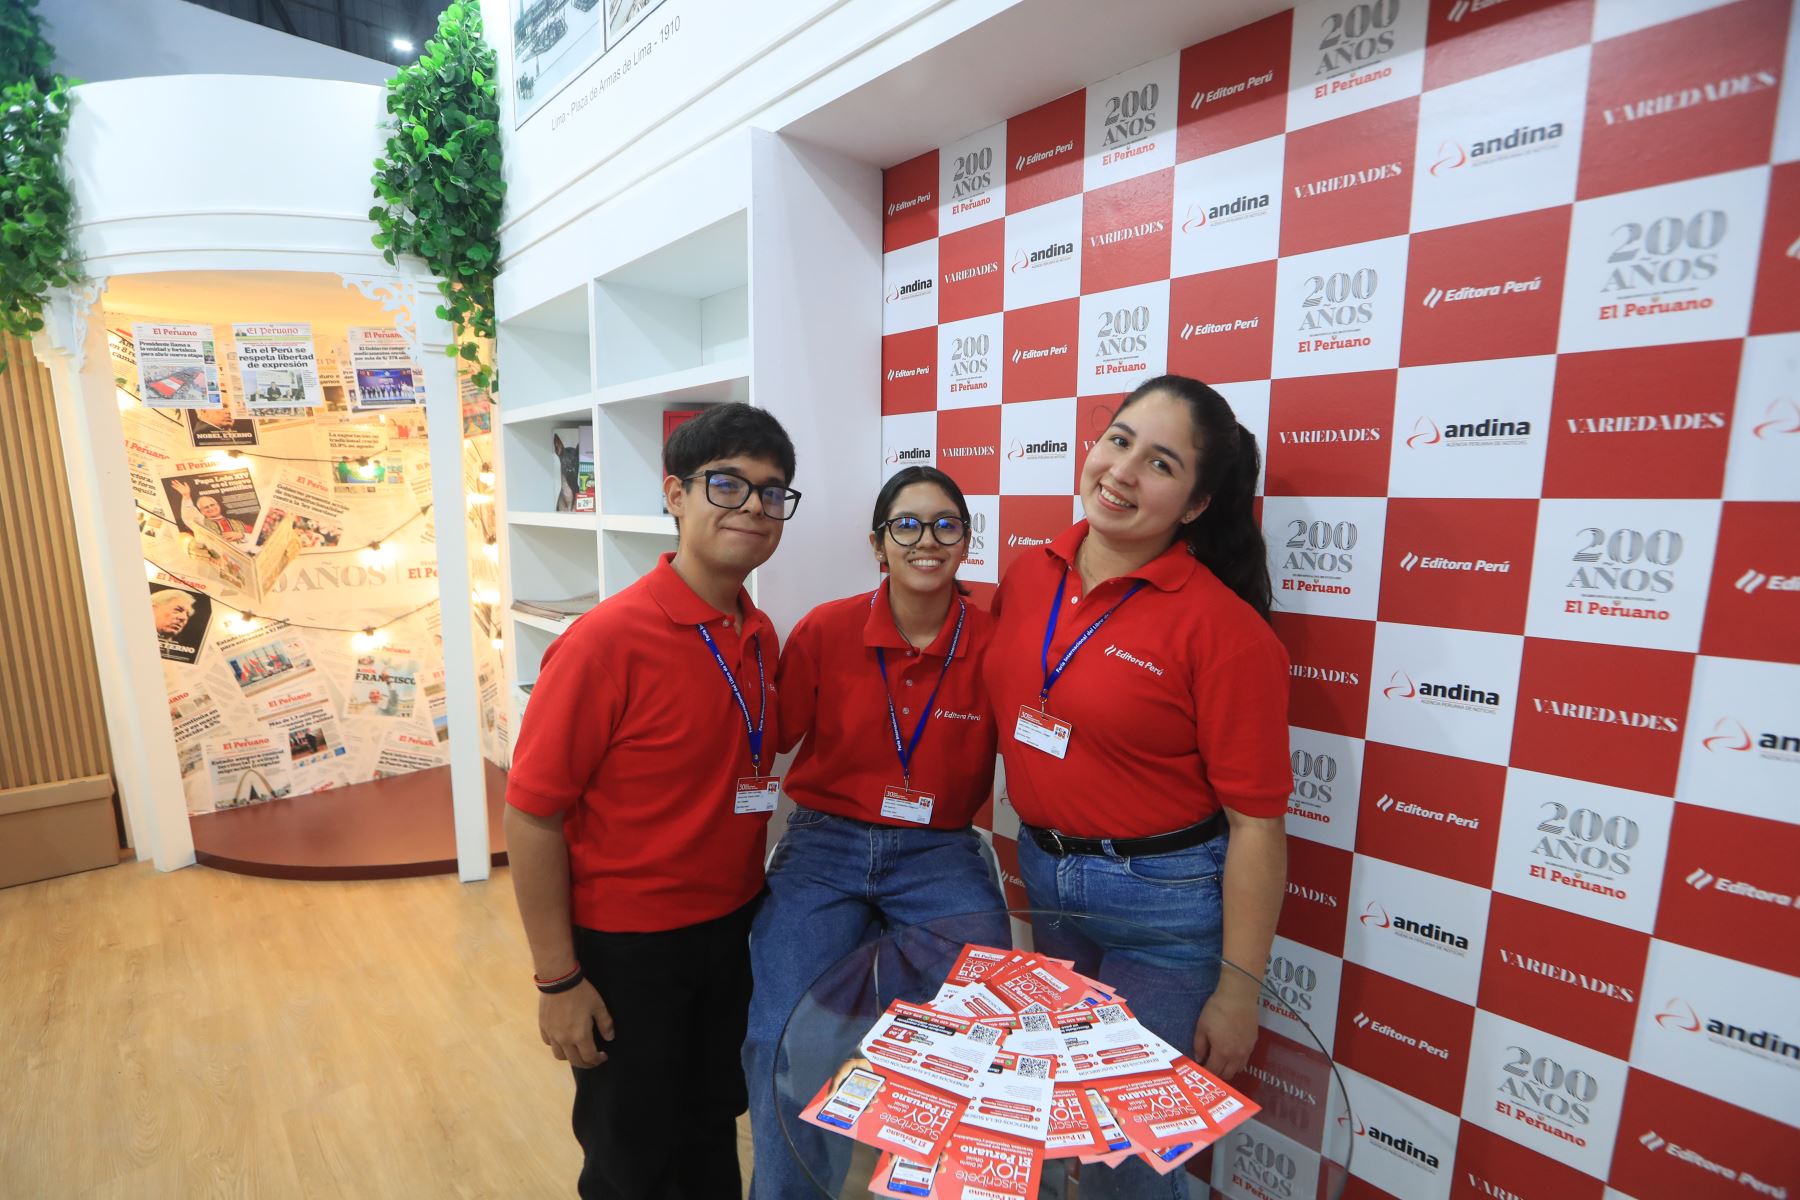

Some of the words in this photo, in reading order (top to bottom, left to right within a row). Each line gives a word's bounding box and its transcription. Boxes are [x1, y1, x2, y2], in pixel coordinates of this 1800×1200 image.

[1318, 0, 1399, 50] 200
[1315, 30, 1394, 76] AÑOS
[551, 112, 566, 131] Lima
[570, 97, 589, 116] Plaza
[590, 86, 598, 99] de
[600, 71, 621, 93] Armas
[623, 58, 631, 74] de
[634, 42, 652, 66] Lima
[660, 15, 681, 44] 1910
[1314, 85, 1328, 99] El
[1331, 67, 1392, 94] Peruano
[1206, 83, 1244, 102] Editora
[1247, 70, 1273, 92] Perú
[1602, 69, 1778, 125] VARIEDADES
[1105, 83, 1159, 126] 200
[1102, 112, 1156, 147] AÑOS
[1470, 121, 1563, 159] andina
[954, 147, 992, 181] 200
[1026, 150, 1054, 165] Editora
[1055, 140, 1073, 156] Perú
[1102, 155, 1112, 166] El
[1114, 142, 1155, 162] Peruano
[952, 171, 991, 198] AÑOS
[1294, 162, 1402, 198] VARIEDADES
[895, 198, 917, 212] Editora
[918, 192, 931, 206] Perú
[952, 204, 960, 215] El
[963, 196, 991, 213] Peruano
[1208, 194, 1270, 219] andina
[1090, 220, 1164, 247] VARIEDADES
[1606, 208, 1728, 264] 200
[1030, 242, 1073, 262] andina
[944, 262, 998, 284] VARIEDADES
[1600, 252, 1718, 294] AÑOS
[900, 278, 932, 296] andina
[1302, 268, 1378, 308] 200
[1444, 284, 1500, 303] Editora
[1503, 277, 1542, 296] Perú
[1299, 302, 1373, 331] AÑOS
[1598, 305, 1618, 321] El
[1623, 295, 1713, 318] Peruano
[164, 328, 197, 336] Peruano
[261, 327, 298, 336] Peruano
[1097, 305, 1150, 338] 200
[1194, 322, 1231, 335] Editora
[1234, 317, 1259, 330] Perú
[951, 333, 989, 360] 200
[1023, 348, 1049, 359] Editora
[1050, 344, 1068, 356] Perú
[1095, 334, 1147, 357] AÑOS
[1298, 341, 1313, 354] El
[1314, 336, 1371, 352] Peruano
[262, 361, 308, 369] expresión
[895, 367, 915, 378] Editora
[916, 366, 929, 376] Perú
[950, 357, 988, 377] AÑOS
[1095, 365, 1105, 375] El
[1106, 361, 1146, 374] Peruano
[950, 383, 958, 392] El
[960, 381, 987, 391] Peruano
[1444, 418, 1530, 439] andina
[1567, 412, 1725, 433] VARIEDADES
[1026, 440, 1067, 454] andina
[1279, 427, 1380, 444] VARIEDADES
[899, 448, 930, 459] andina
[942, 446, 995, 458] VARIEDADES
[1286, 520, 1357, 550] 200
[1572, 527, 1684, 566] 200
[1282, 547, 1353, 573] AÑOS
[1420, 557, 1472, 571] Editora
[1474, 560, 1510, 573] Perú
[292, 560, 386, 591] AÑOS
[408, 568, 421, 579] El
[1565, 562, 1675, 594] AÑOS
[1282, 579, 1294, 590] El
[1297, 580, 1351, 594] Peruano
[1564, 600, 1582, 613] El
[1587, 602, 1670, 620] Peruano
[1056, 661, 1066, 673] Feria
[1064, 634, 1087, 662] Internacional
[1086, 627, 1094, 636] del
[1093, 617, 1104, 631] Libro
[1116, 649, 1144, 666] Editora
[1145, 662, 1163, 676] Perú
[268, 700, 277, 708] El
[280, 692, 311, 704] Peruano
[1419, 682, 1499, 706] andina
[944, 711, 966, 720] Editora
[1533, 698, 1679, 732] VARIEDADES
[234, 738, 270, 749] Peruano
[1395, 802, 1443, 821] Editora
[1446, 813, 1479, 830] Perú
[1537, 802, 1640, 850] 200
[1530, 836, 1631, 875] AÑOS
[1529, 865, 1545, 879] El
[1550, 868, 1627, 900] Peruano
[1715, 878, 1792, 907] Editora
[1393, 916, 1468, 950] andina
[1012, 976, 1042, 994] HOY
[1500, 949, 1633, 1003] VARIEDADES
[1371, 1021, 1416, 1047] Editora
[1419, 1039, 1449, 1059] Perú
[1503, 1045, 1598, 1103] 200
[1118, 1086, 1168, 1101] Peruano
[1165, 1084, 1181, 1094] El
[1497, 1076, 1590, 1126] AÑOS
[892, 1092, 939, 1114] Peruano
[940, 1108, 954, 1119] El
[1150, 1093, 1190, 1112] HOY
[904, 1108, 949, 1132] HOY
[1155, 1121, 1188, 1130] Peruano
[1495, 1100, 1511, 1116] El
[1515, 1108, 1586, 1148] Peruano
[960, 1145, 1016, 1164] Peruano
[1235, 1132, 1296, 1180] 200
[1369, 1126, 1439, 1170] andina
[982, 1160, 1030, 1182] HOY
[1019, 1157, 1032, 1167] El
[1666, 1142, 1735, 1181] Editora
[1738, 1170, 1786, 1200] Perú
[1234, 1156, 1292, 1198] AÑOS
